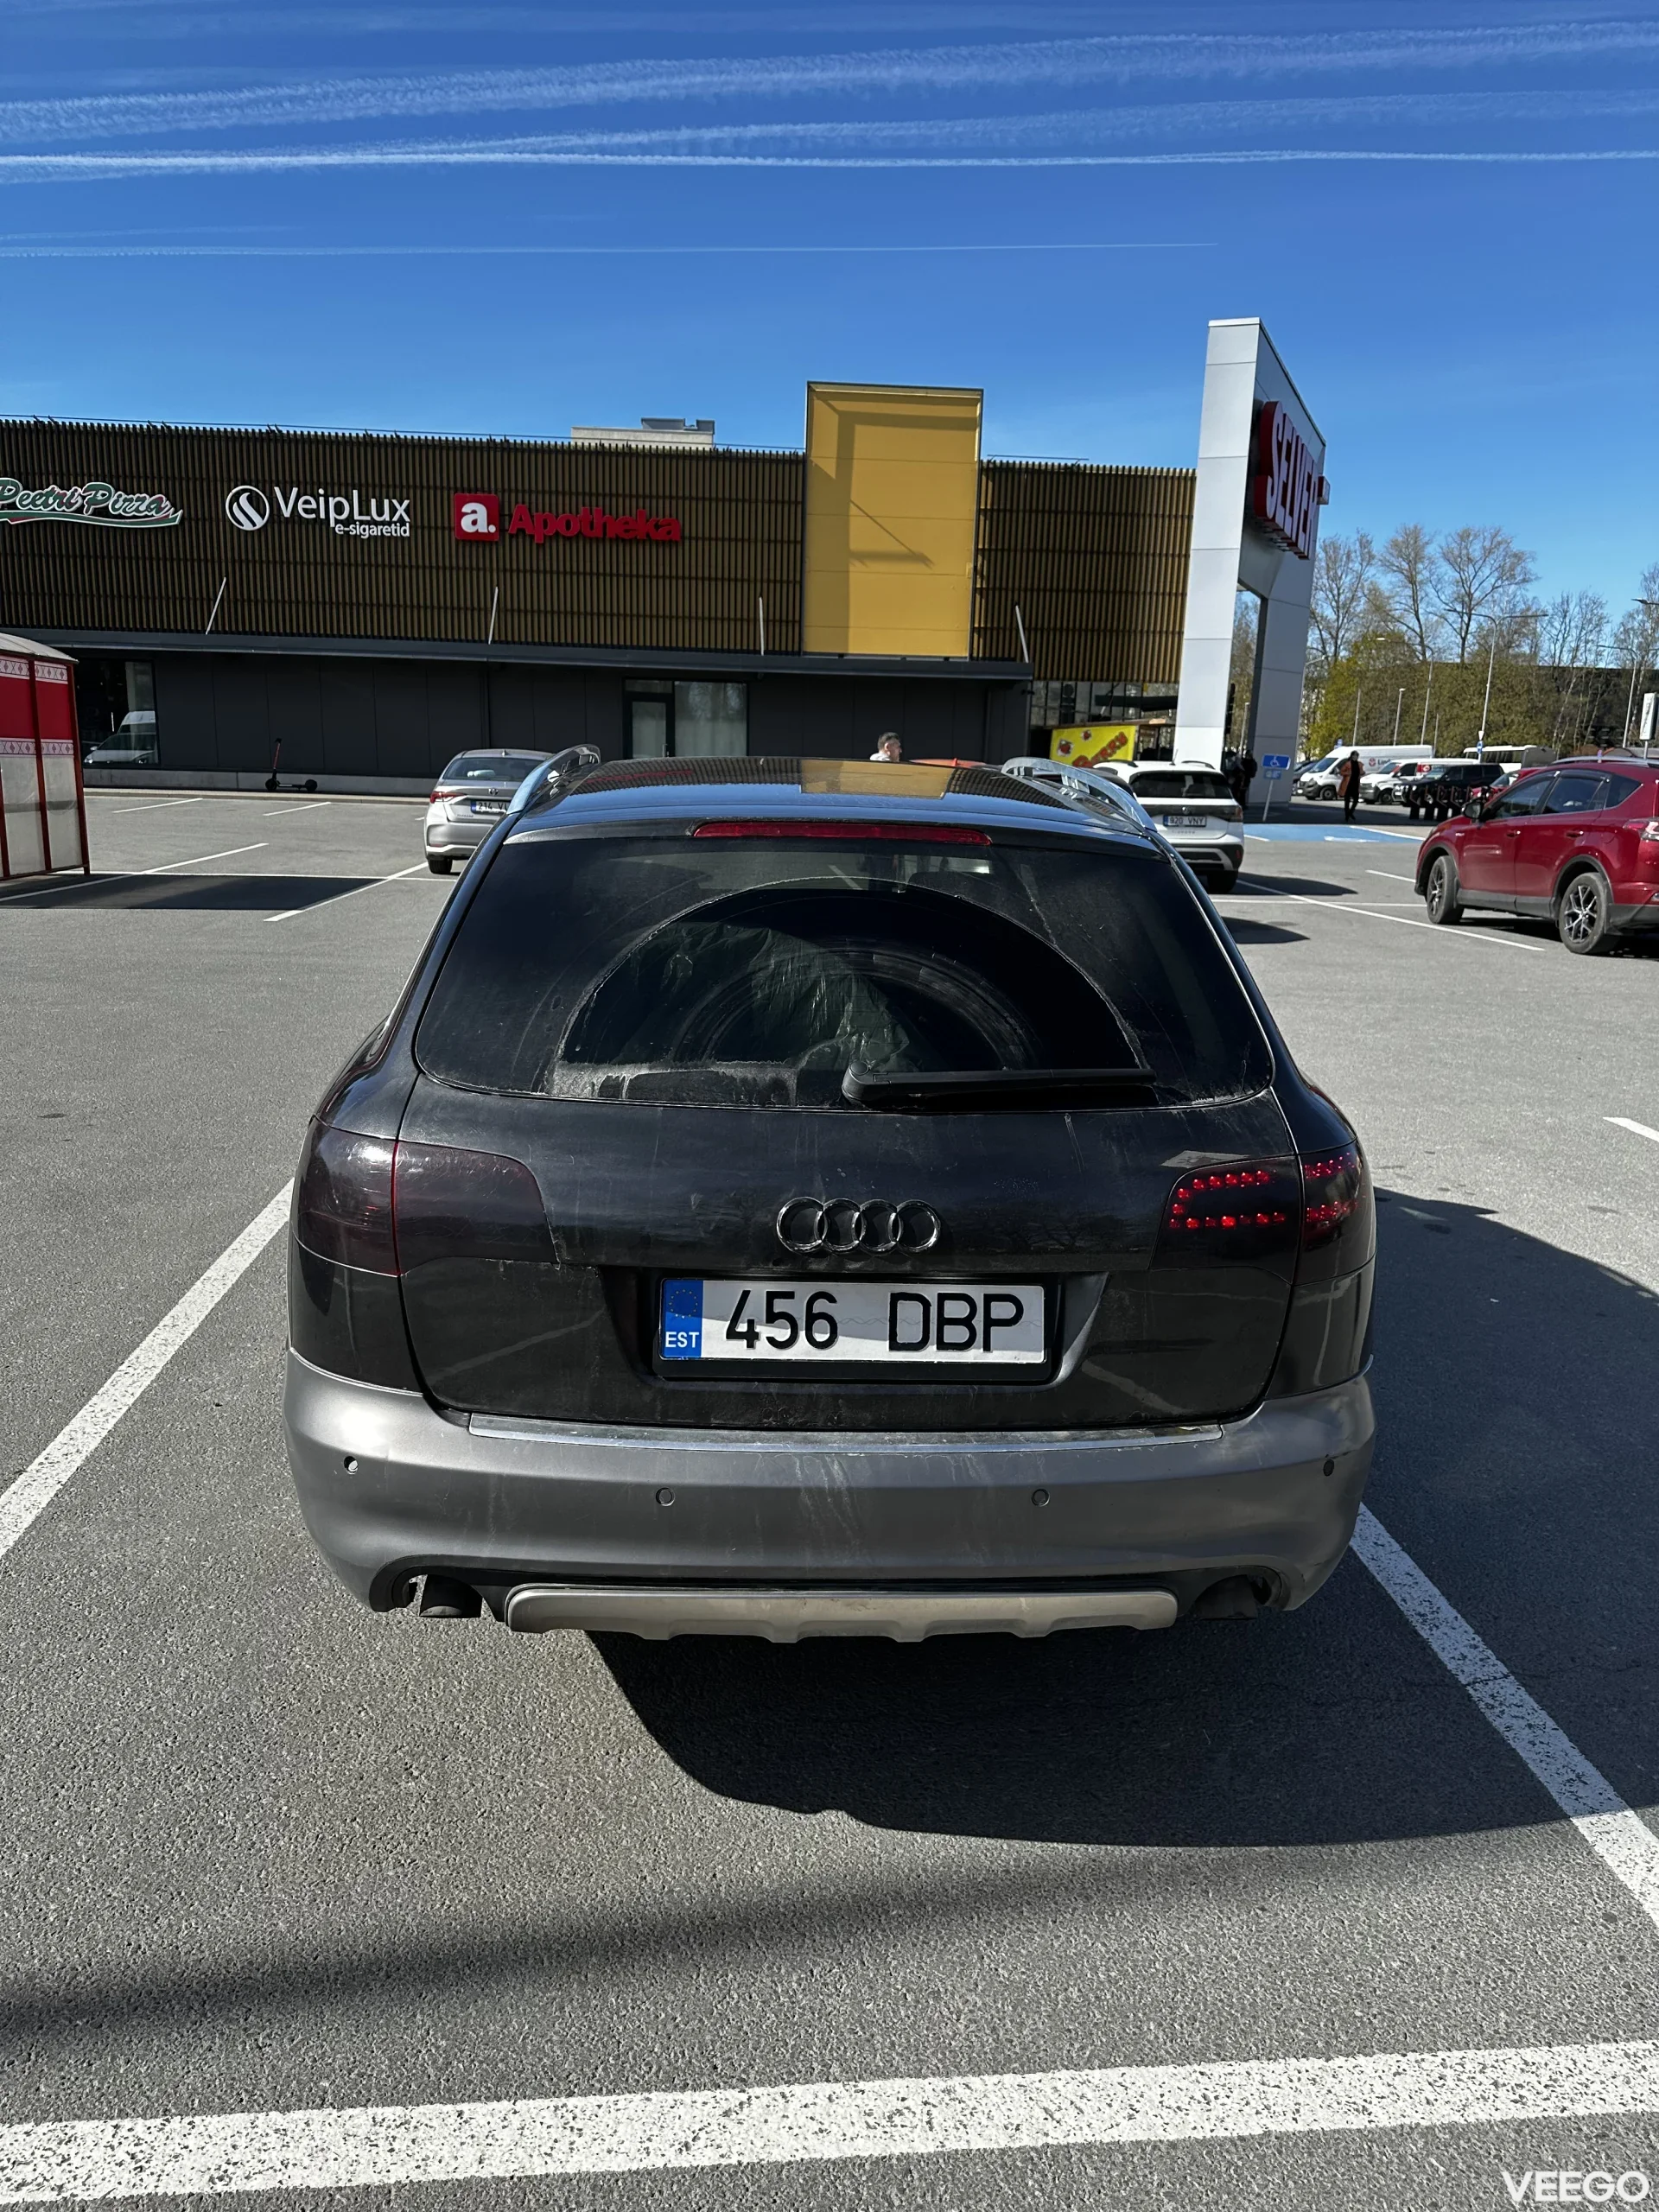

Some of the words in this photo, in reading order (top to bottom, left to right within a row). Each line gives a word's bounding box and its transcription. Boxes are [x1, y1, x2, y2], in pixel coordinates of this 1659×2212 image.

[0, 478, 83, 512] Peetri
[81, 481, 175, 516] Pizza
[1262, 401, 1319, 560] SELVER
[273, 486, 410, 527] VeipLux
[508, 505, 681, 543] Apotheka
[334, 521, 410, 539] e-sigaretid
[665, 1332, 700, 1348] EST
[725, 1290, 838, 1351] 456
[888, 1292, 1025, 1353] DBP
